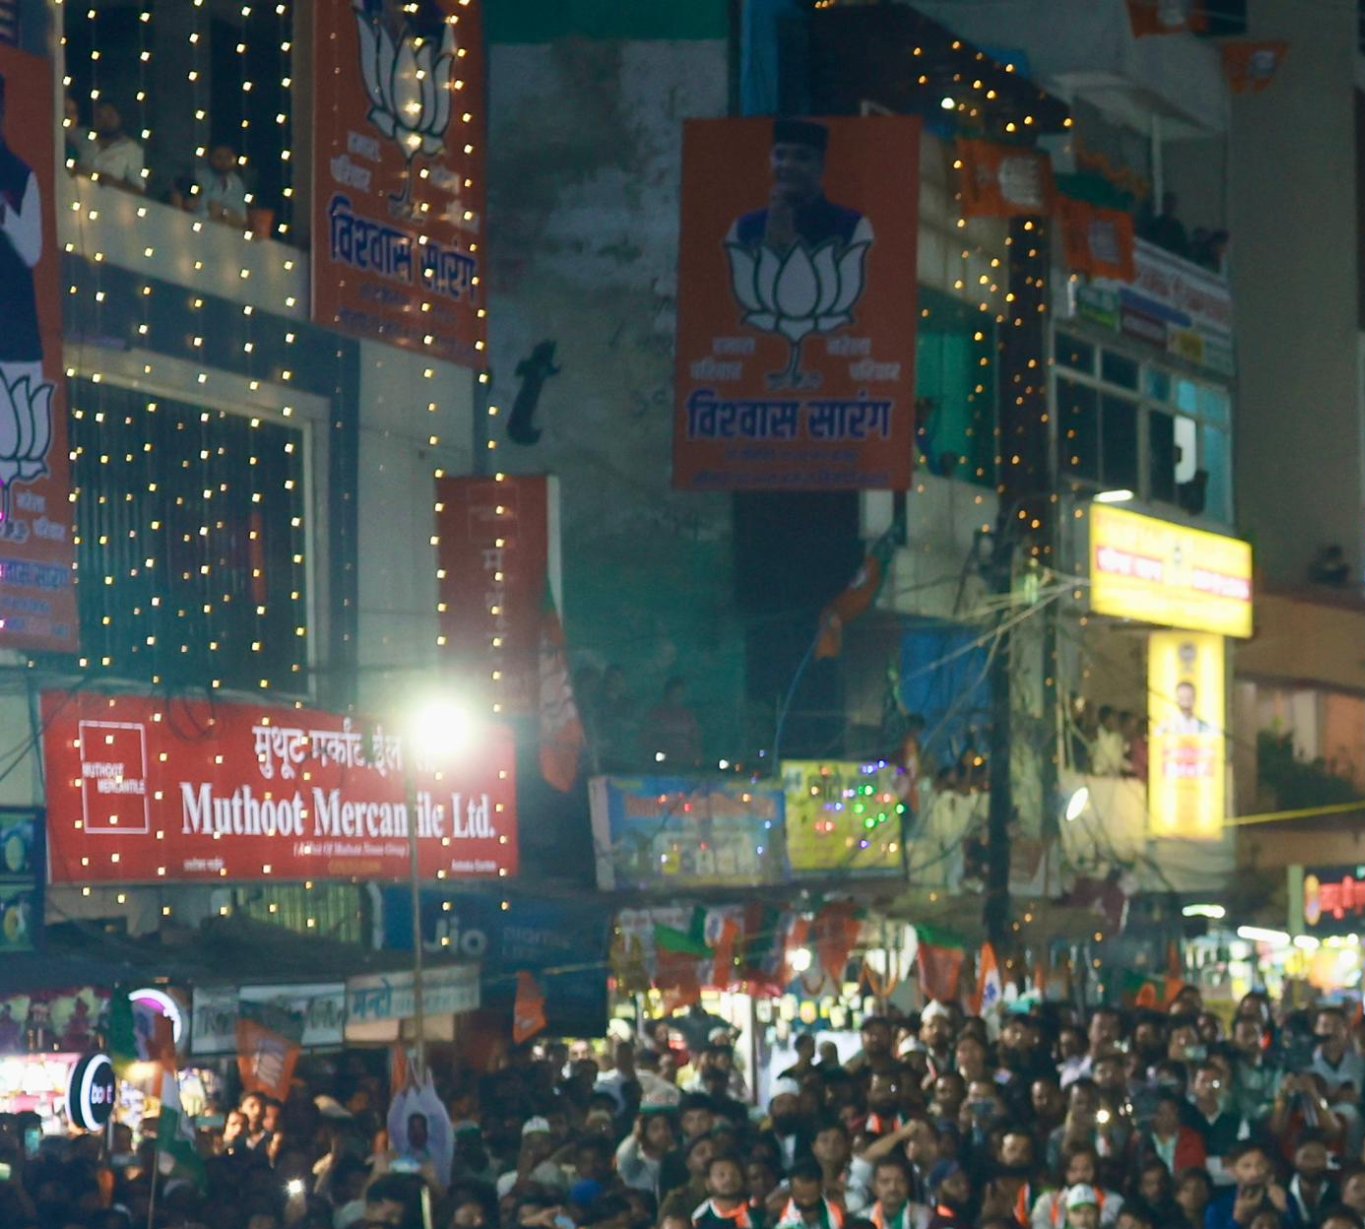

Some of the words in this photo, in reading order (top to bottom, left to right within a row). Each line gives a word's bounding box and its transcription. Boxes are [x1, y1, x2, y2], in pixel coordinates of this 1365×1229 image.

[687, 389, 800, 438] विश्वास
[807, 390, 894, 439] सारंग
[180, 781, 304, 837] Muthoot
[312, 787, 445, 839] Mercanile
[451, 791, 497, 839] Ltd.
[424, 916, 488, 956] Jio
